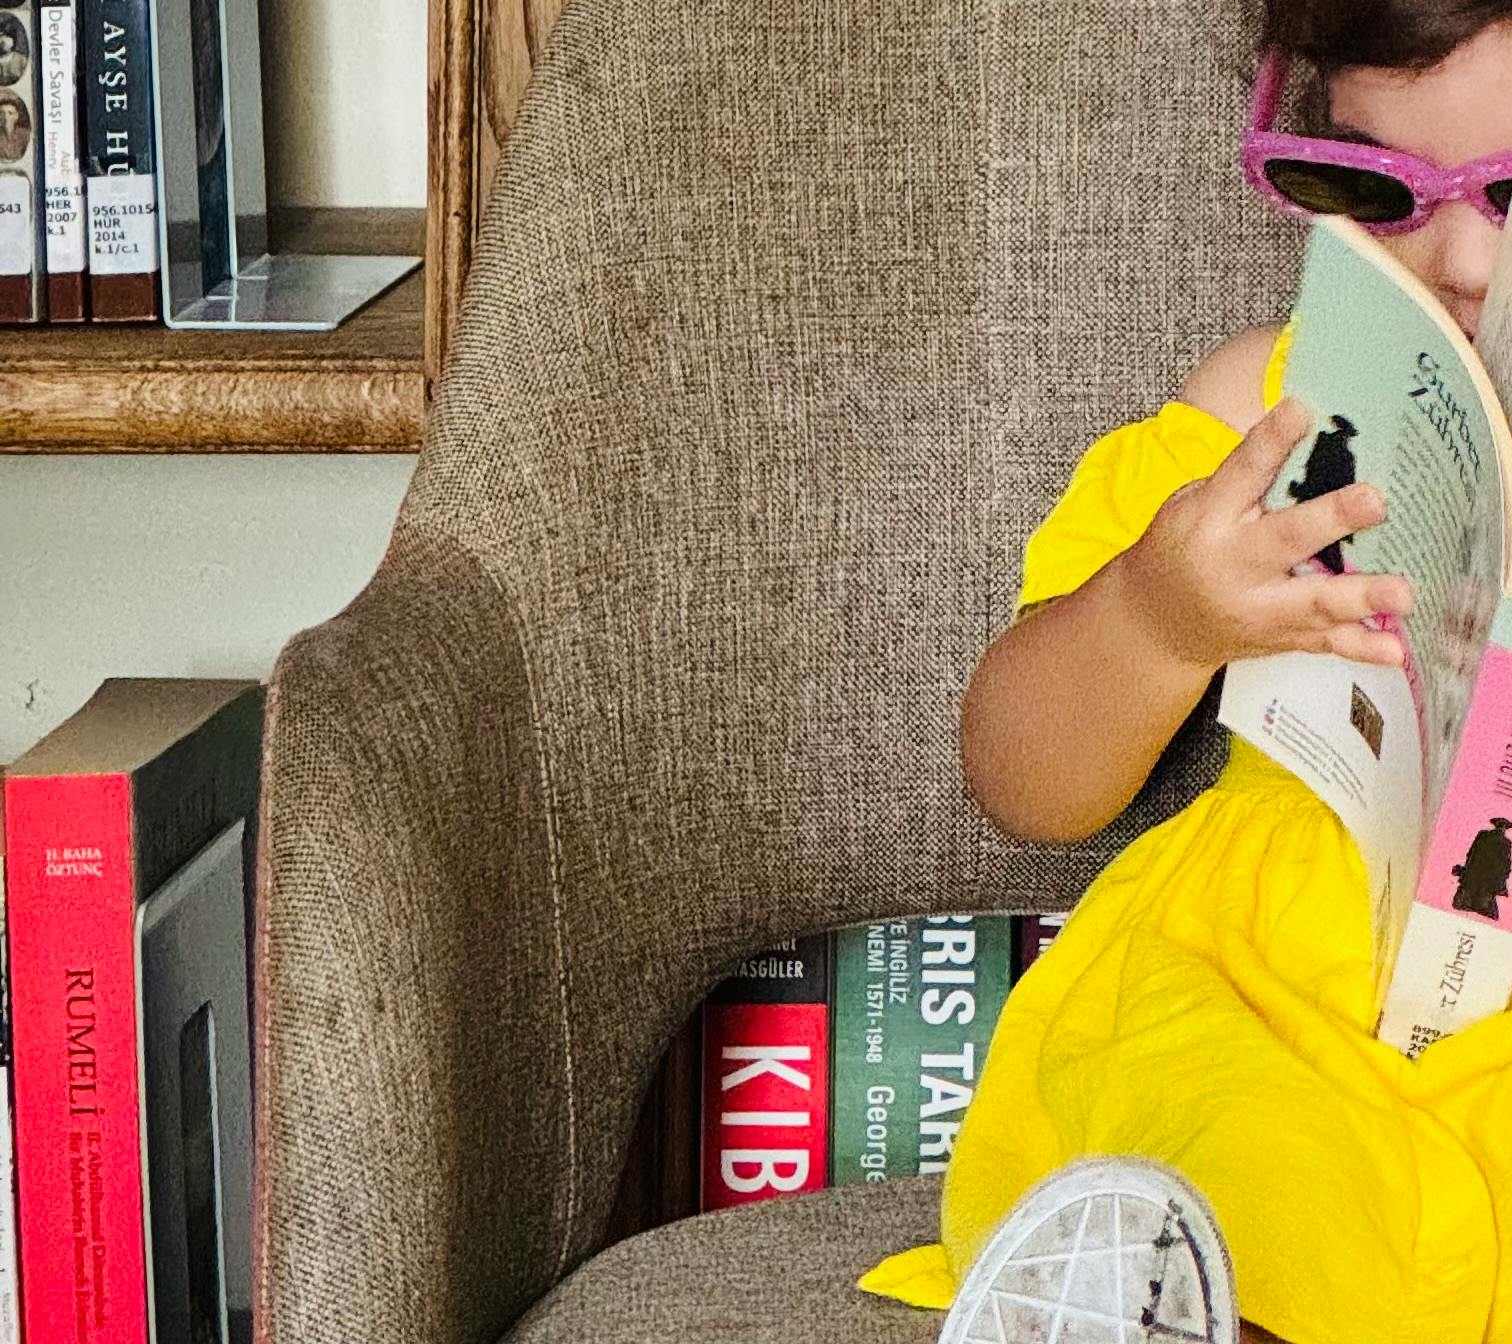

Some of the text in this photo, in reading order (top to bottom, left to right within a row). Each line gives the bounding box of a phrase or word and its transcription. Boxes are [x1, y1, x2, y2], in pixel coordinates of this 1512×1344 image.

[64, 968, 106, 1115] RUMELİ
[866, 982, 884, 1063] 1571-1948
[860, 1086, 895, 1184] George
